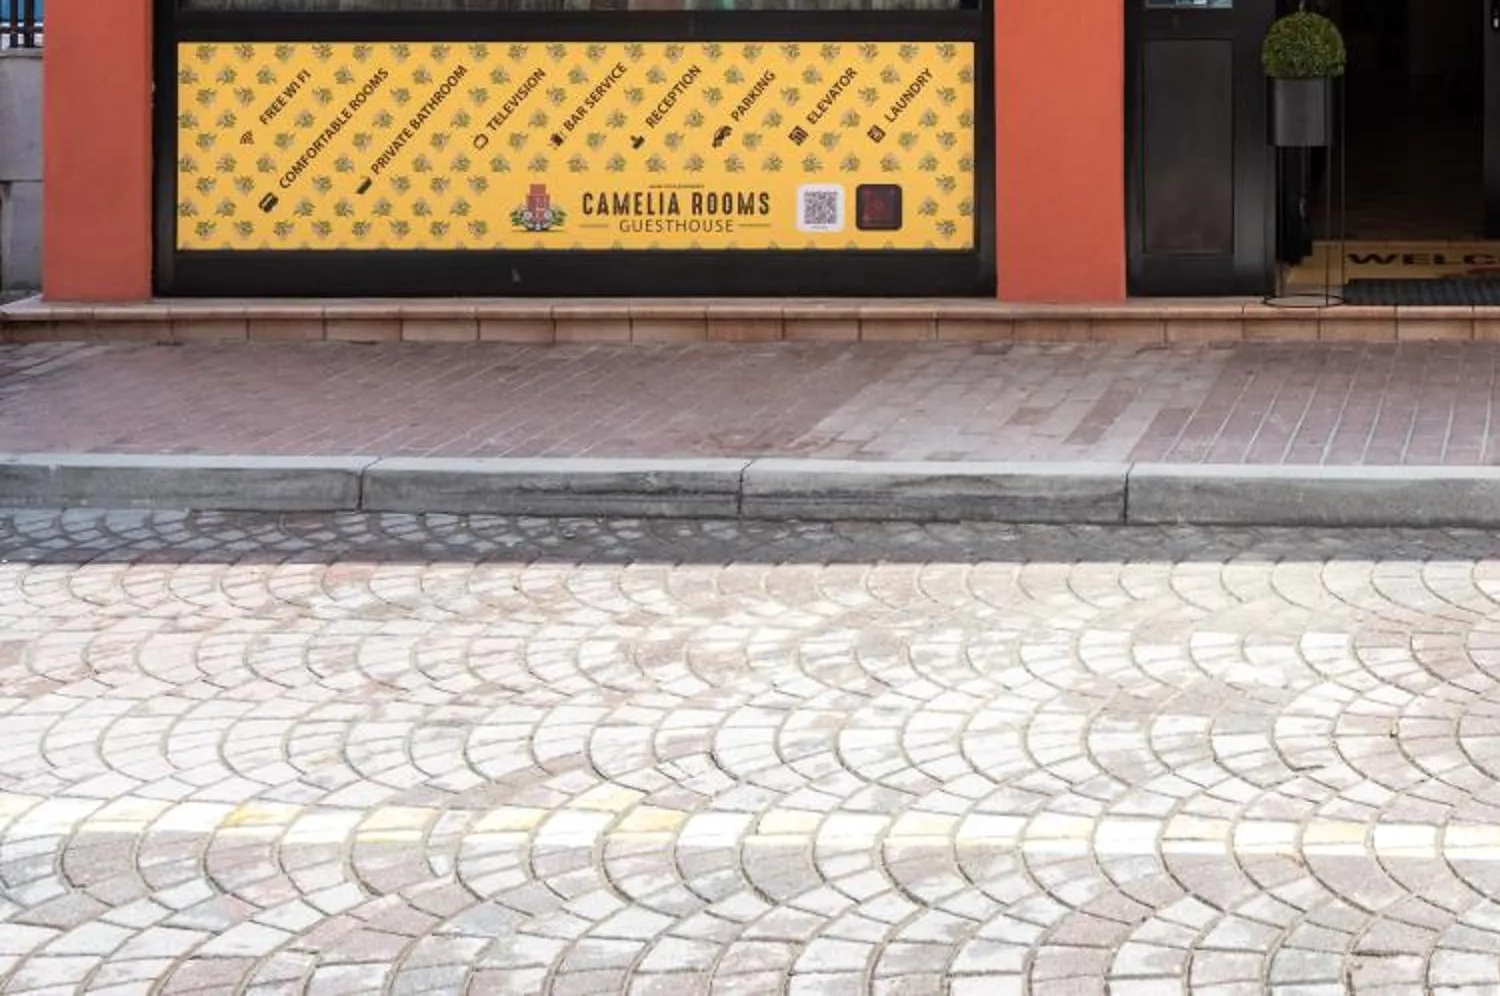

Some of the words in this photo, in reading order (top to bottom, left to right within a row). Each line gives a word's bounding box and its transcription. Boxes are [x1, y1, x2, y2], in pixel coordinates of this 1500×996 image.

[259, 95, 287, 124] FREE
[283, 80, 301, 98] WI
[297, 68, 311, 83] FI
[371, 127, 413, 175] PRIVATE
[409, 64, 468, 131] BATHROOM
[486, 67, 546, 131] TELEVISION
[563, 105, 588, 131] BAR
[584, 62, 627, 109] SERVICE
[645, 64, 702, 129] RECEPTION
[730, 69, 776, 122] PARKING
[805, 67, 858, 125] ELEVATOR
[883, 67, 933, 123] LAUNDRY
[279, 108, 353, 189] COMFORTABLE
[348, 67, 389, 112] ROOMS
[582, 191, 681, 216] CAMELIA
[691, 191, 770, 216] ROOMS
[619, 219, 734, 233] GUESTHOUSE
